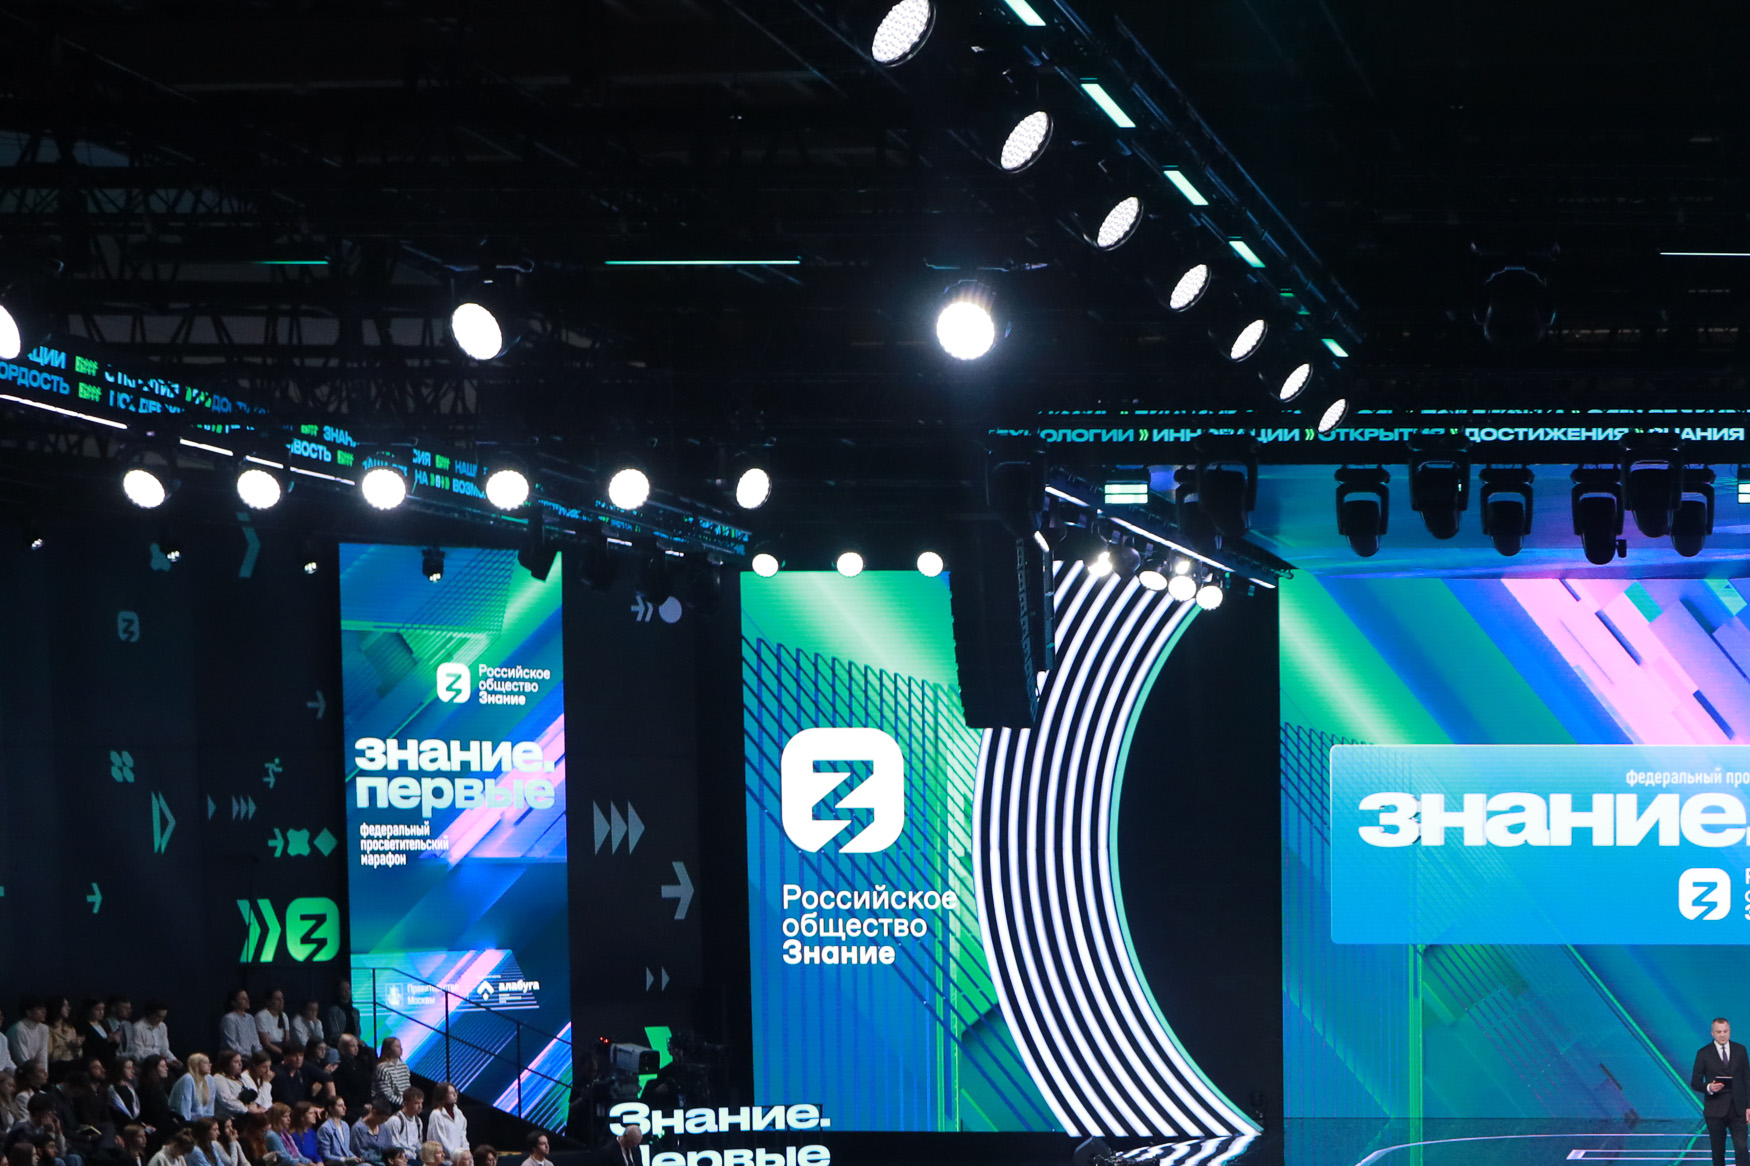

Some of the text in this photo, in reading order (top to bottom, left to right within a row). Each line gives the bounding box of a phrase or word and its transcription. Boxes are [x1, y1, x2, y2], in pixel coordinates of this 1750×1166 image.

[0, 361, 70, 396] ОРДОСТЬ
[1465, 427, 1630, 442] ДОСТИЖЕНИЯ
[478, 664, 551, 680] Российское
[478, 679, 539, 694] общество
[478, 691, 526, 706] Знание
[354, 737, 556, 773] знание.
[1626, 767, 1722, 788] федеральный
[355, 775, 556, 819] первые
[360, 821, 430, 839] федеральный
[360, 836, 450, 854] просветительский
[360, 851, 407, 869] марафон
[782, 884, 958, 910] Российское
[782, 912, 928, 940] общество
[782, 939, 896, 965] Знание
[498, 979, 540, 993] алабуга
[608, 1102, 831, 1136] Знание.
